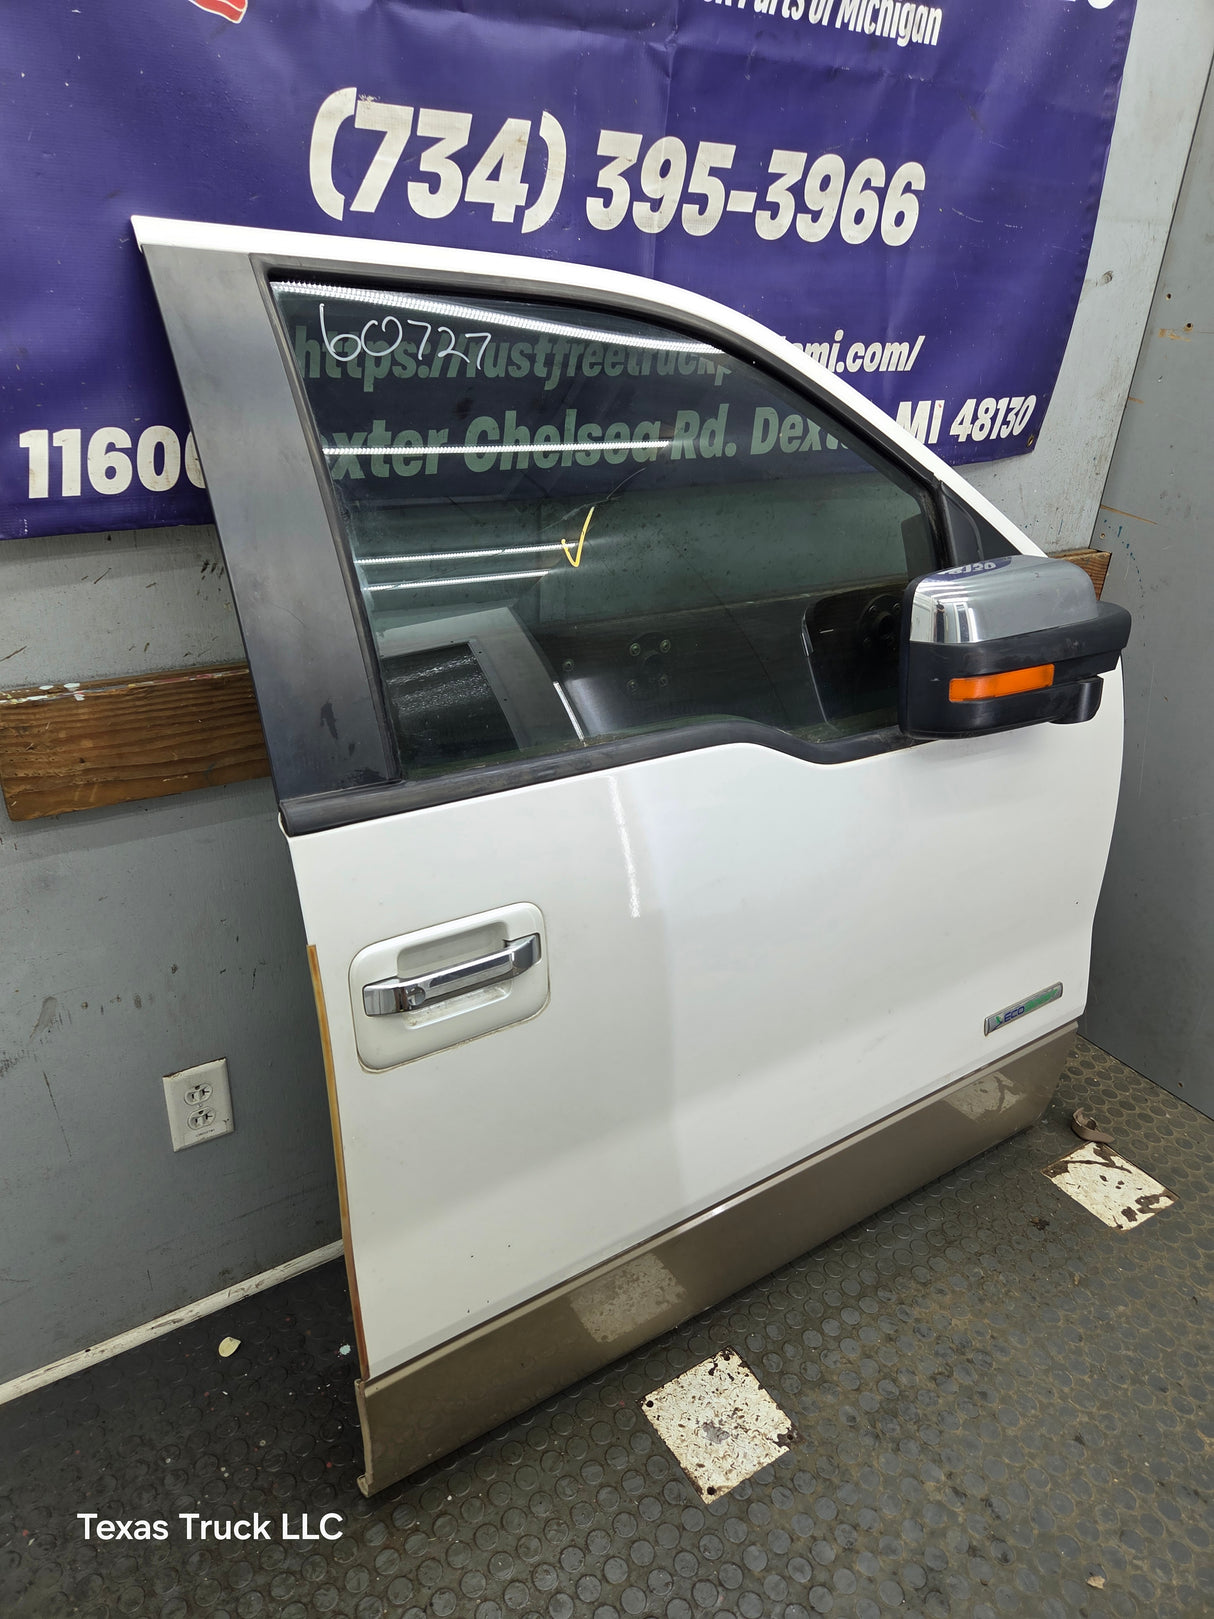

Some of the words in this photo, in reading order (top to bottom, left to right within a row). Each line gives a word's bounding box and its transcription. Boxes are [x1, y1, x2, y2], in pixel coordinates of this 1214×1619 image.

[835, 0, 942, 47] Michigan
[309, 87, 568, 234] (734)
[586, 129, 926, 247] 395-3966
[319, 303, 492, 371] 60727
[464, 409, 662, 474] Chelsea
[671, 404, 737, 460] Rd.
[895, 400, 945, 444] MI
[950, 395, 1037, 443] 48130
